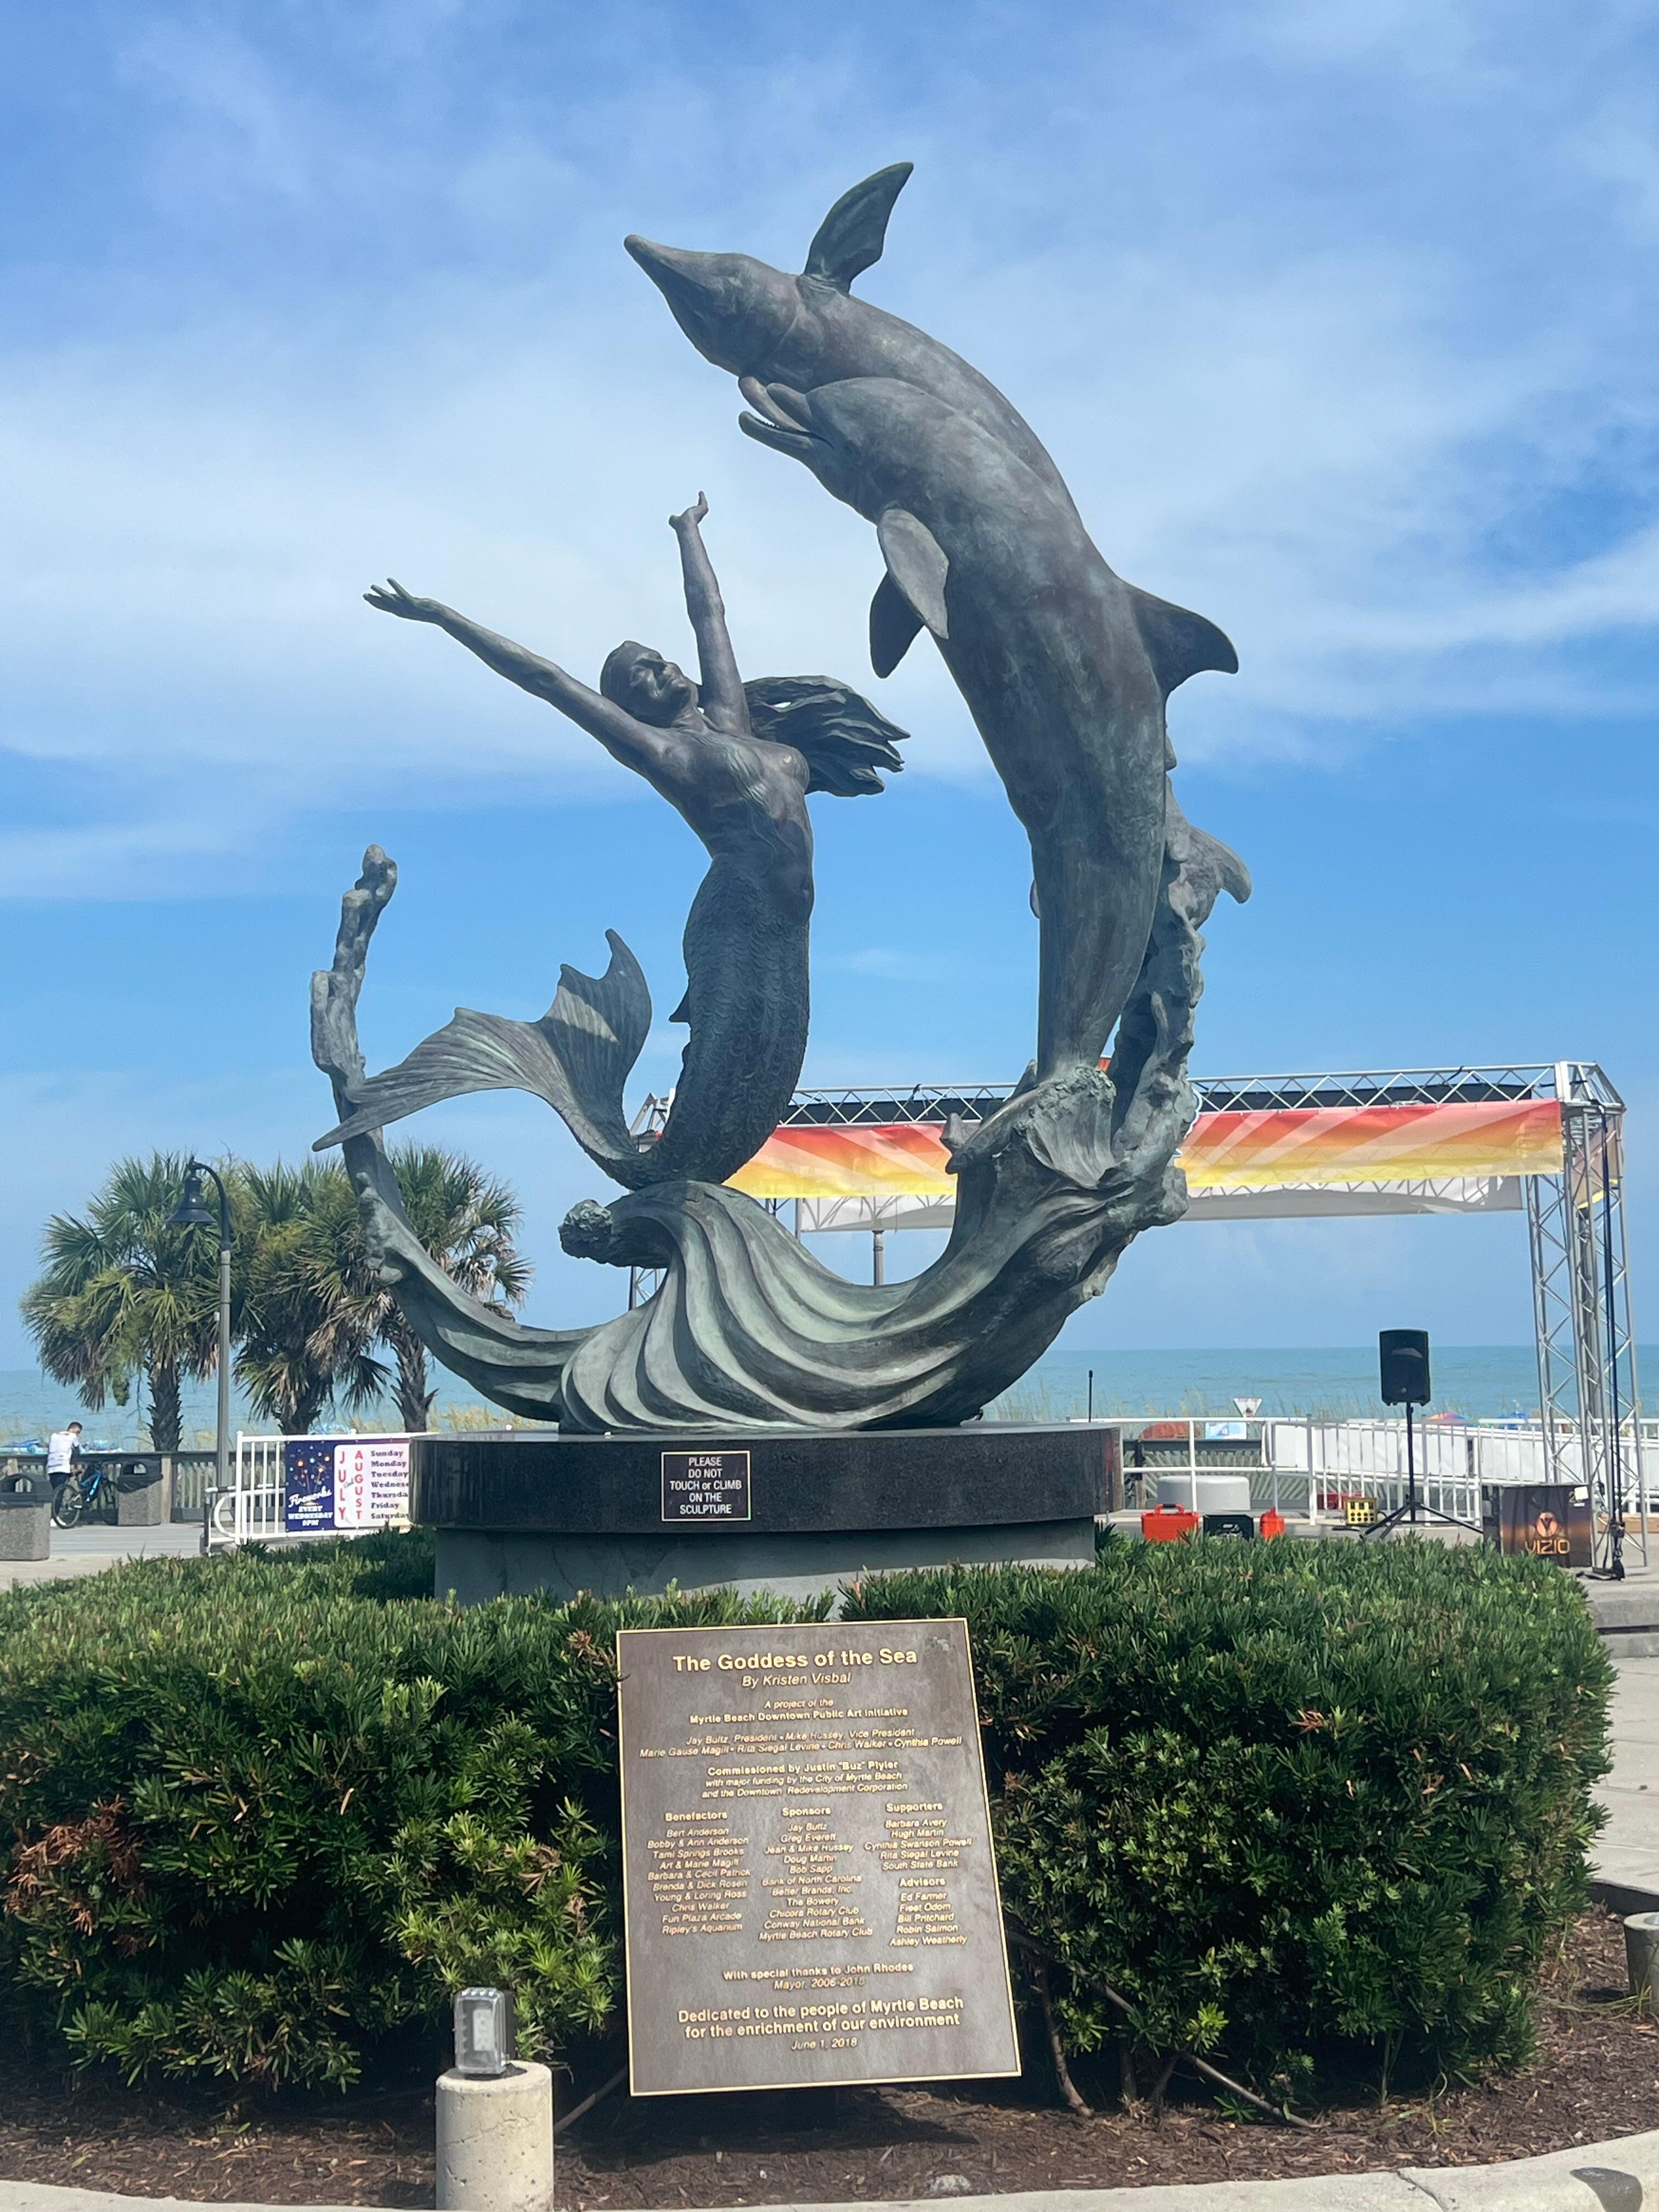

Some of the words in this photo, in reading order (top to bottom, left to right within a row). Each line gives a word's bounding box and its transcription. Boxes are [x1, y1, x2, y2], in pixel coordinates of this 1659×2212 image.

[689, 1457, 723, 1466] PLEASE
[371, 1470, 409, 1479] Tuesday
[687, 1469, 702, 1478] DO
[703, 1468, 723, 1478] NOT
[354, 1450, 364, 1520] AUGUST
[669, 1480, 700, 1491] TOUCH
[702, 1482, 712, 1490] or
[713, 1480, 742, 1491] CLIMB
[689, 1492, 703, 1503] ON
[704, 1492, 723, 1503] THE
[371, 1502, 400, 1510] Friday
[679, 1504, 732, 1515] SCULPTURE
[1525, 1539, 1571, 1555] VIZIO
[673, 1656, 711, 1671] The
[718, 1652, 808, 1669] Goddess
[814, 1650, 834, 1667] of
[840, 1650, 873, 1666] the
[879, 1648, 917, 1663] Sea
[742, 1675, 759, 1689] By
[763, 1675, 807, 1685] Kristen
[812, 1672, 851, 1684] Visbal
[774, 1701, 805, 1710] project
[808, 1699, 817, 1707] of
[690, 1714, 721, 1725] Myrtle
[724, 1713, 755, 1722] Beach
[758, 1712, 810, 1720] Downtown
[813, 1710, 844, 1718] Public
[865, 1708, 908, 1717] Initiative
[733, 1734, 777, 1743] President
[785, 1733, 807, 1741] Mike
[849, 1730, 869, 1738] Vice
[872, 1728, 915, 1737] President
[828, 1741, 851, 1750] Chris
[854, 1740, 887, 1748] Walker
[931, 1735, 962, 1746] Powell
[708, 1764, 785, 1776] Commissioned
[788, 1764, 800, 1774] by
[804, 1762, 836, 1772] Justin
[706, 1779, 724, 1787] with
[726, 1779, 751, 1787] major
[752, 1777, 784, 1786] funding
[787, 1776, 797, 1785] by
[815, 1774, 833, 1784] City
[834, 1773, 844, 1781] of
[845, 1773, 872, 1783] Myrtle
[874, 1771, 902, 1780] Beach
[702, 1790, 719, 1798] and
[721, 1789, 734, 1797] the
[737, 1788, 782, 1796] Downtown
[787, 1785, 855, 1794] Redevelopment
[857, 1783, 907, 1792] Corporation
[782, 1807, 831, 1818] Sponsors
[886, 1803, 943, 1813] Supporters
[665, 1812, 727, 1821] Benefactors
[885, 1820, 919, 1828] Barbara
[687, 1828, 729, 1836] Anderson
[917, 1829, 944, 1837] Martin
[707, 1837, 749, 1846] Anderson
[943, 1838, 972, 1846] Powell
[936, 1859, 958, 1867] Bank
[761, 1877, 785, 1886] Bank
[786, 1876, 797, 1886] of
[798, 1875, 823, 1884] North
[823, 1874, 862, 1883] Carolina
[900, 1877, 946, 1887] Advisors
[672, 1904, 695, 1912] Chris
[698, 1902, 730, 1910] Walker
[787, 1898, 803, 1906] The
[803, 1917, 840, 1927] National
[843, 1917, 865, 1926] Bank
[898, 1915, 912, 1923] Bill
[759, 1932, 787, 1942] Myrtle
[789, 1930, 817, 1939] Beach
[821, 1929, 848, 1938] Rotary
[852, 1927, 873, 1936] Club
[724, 1971, 748, 1979] With
[751, 1968, 788, 1979] special
[792, 1967, 827, 1977] thanks
[846, 1965, 870, 1973] John
[874, 1962, 913, 1972] Rhodes
[679, 2007, 750, 2023] Dedicated
[754, 2007, 769, 2018] to
[774, 2005, 795, 2017] the
[800, 2002, 848, 2019] people
[852, 2001, 866, 2013] of
[871, 1999, 915, 2015] Myrtle
[919, 1996, 963, 2010] Beach
[685, 2025, 706, 2038] for
[710, 2024, 733, 2037] the
[737, 2020, 819, 2035] enrichment
[822, 2018, 837, 2031] of
[841, 2020, 866, 2030] our
[870, 2013, 960, 2029] environment
[792, 2040, 816, 2050] June
[831, 2037, 857, 2047] 2018
